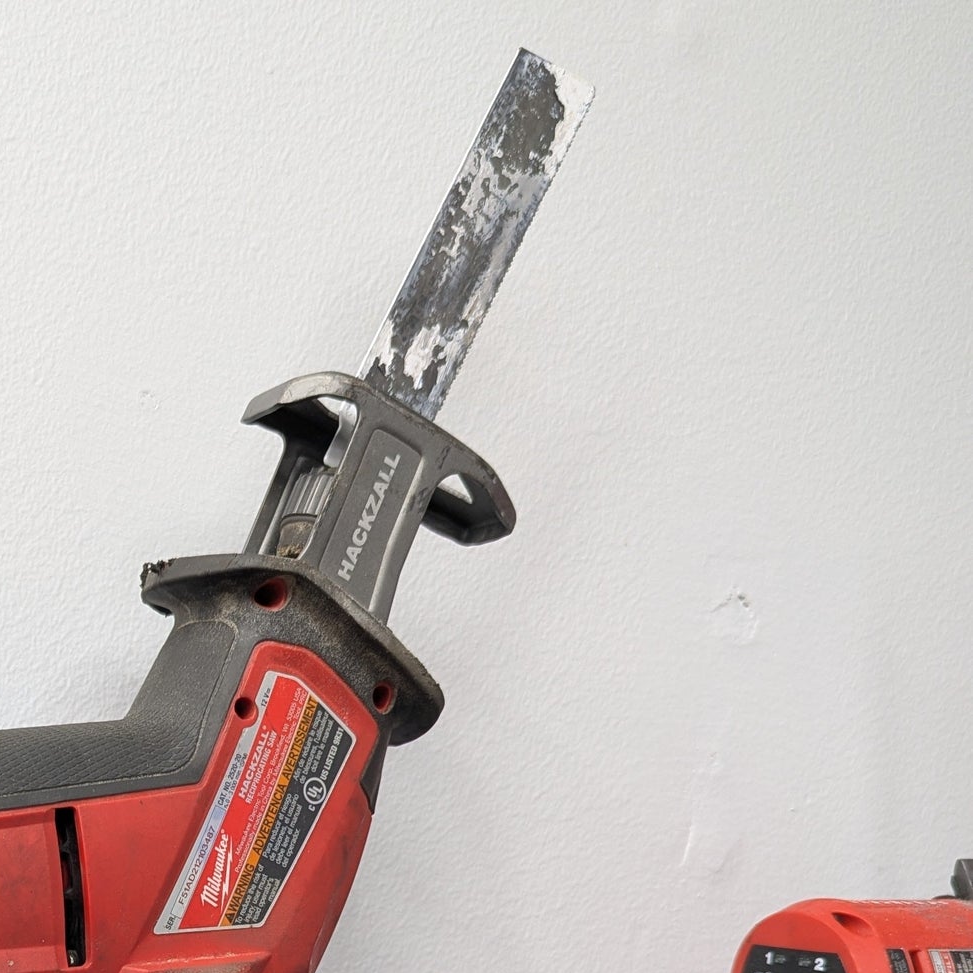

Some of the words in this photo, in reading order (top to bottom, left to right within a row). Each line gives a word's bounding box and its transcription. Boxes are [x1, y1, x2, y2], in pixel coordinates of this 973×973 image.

[338, 454, 401, 581] HACKZALL
[261, 699, 269, 708] 12
[238, 729, 270, 799] HACKZALL
[323, 744, 340, 771] LISTED
[227, 753, 243, 780] 2520-20
[245, 747, 273, 805] RECIPROCATING
[266, 730, 279, 749] SAW
[320, 769, 330, 781] US
[223, 780, 232, 792] NO.
[306, 783, 324, 800] UL
[218, 792, 228, 806] CAT.
[228, 863, 256, 914] WARNING
[252, 783, 288, 856] ADVERTENCIA
[281, 696, 319, 781] AVERTISSEMENT
[201, 833, 230, 908] Milwaukee
[257, 864, 265, 873] of
[252, 872, 262, 884] risk
[248, 883, 258, 895] the
[239, 894, 253, 917] reduce
[165, 914, 177, 931] SER.
[235, 915, 244, 925] To
[765, 951, 773, 965] 1
[813, 957, 826, 972] 2
